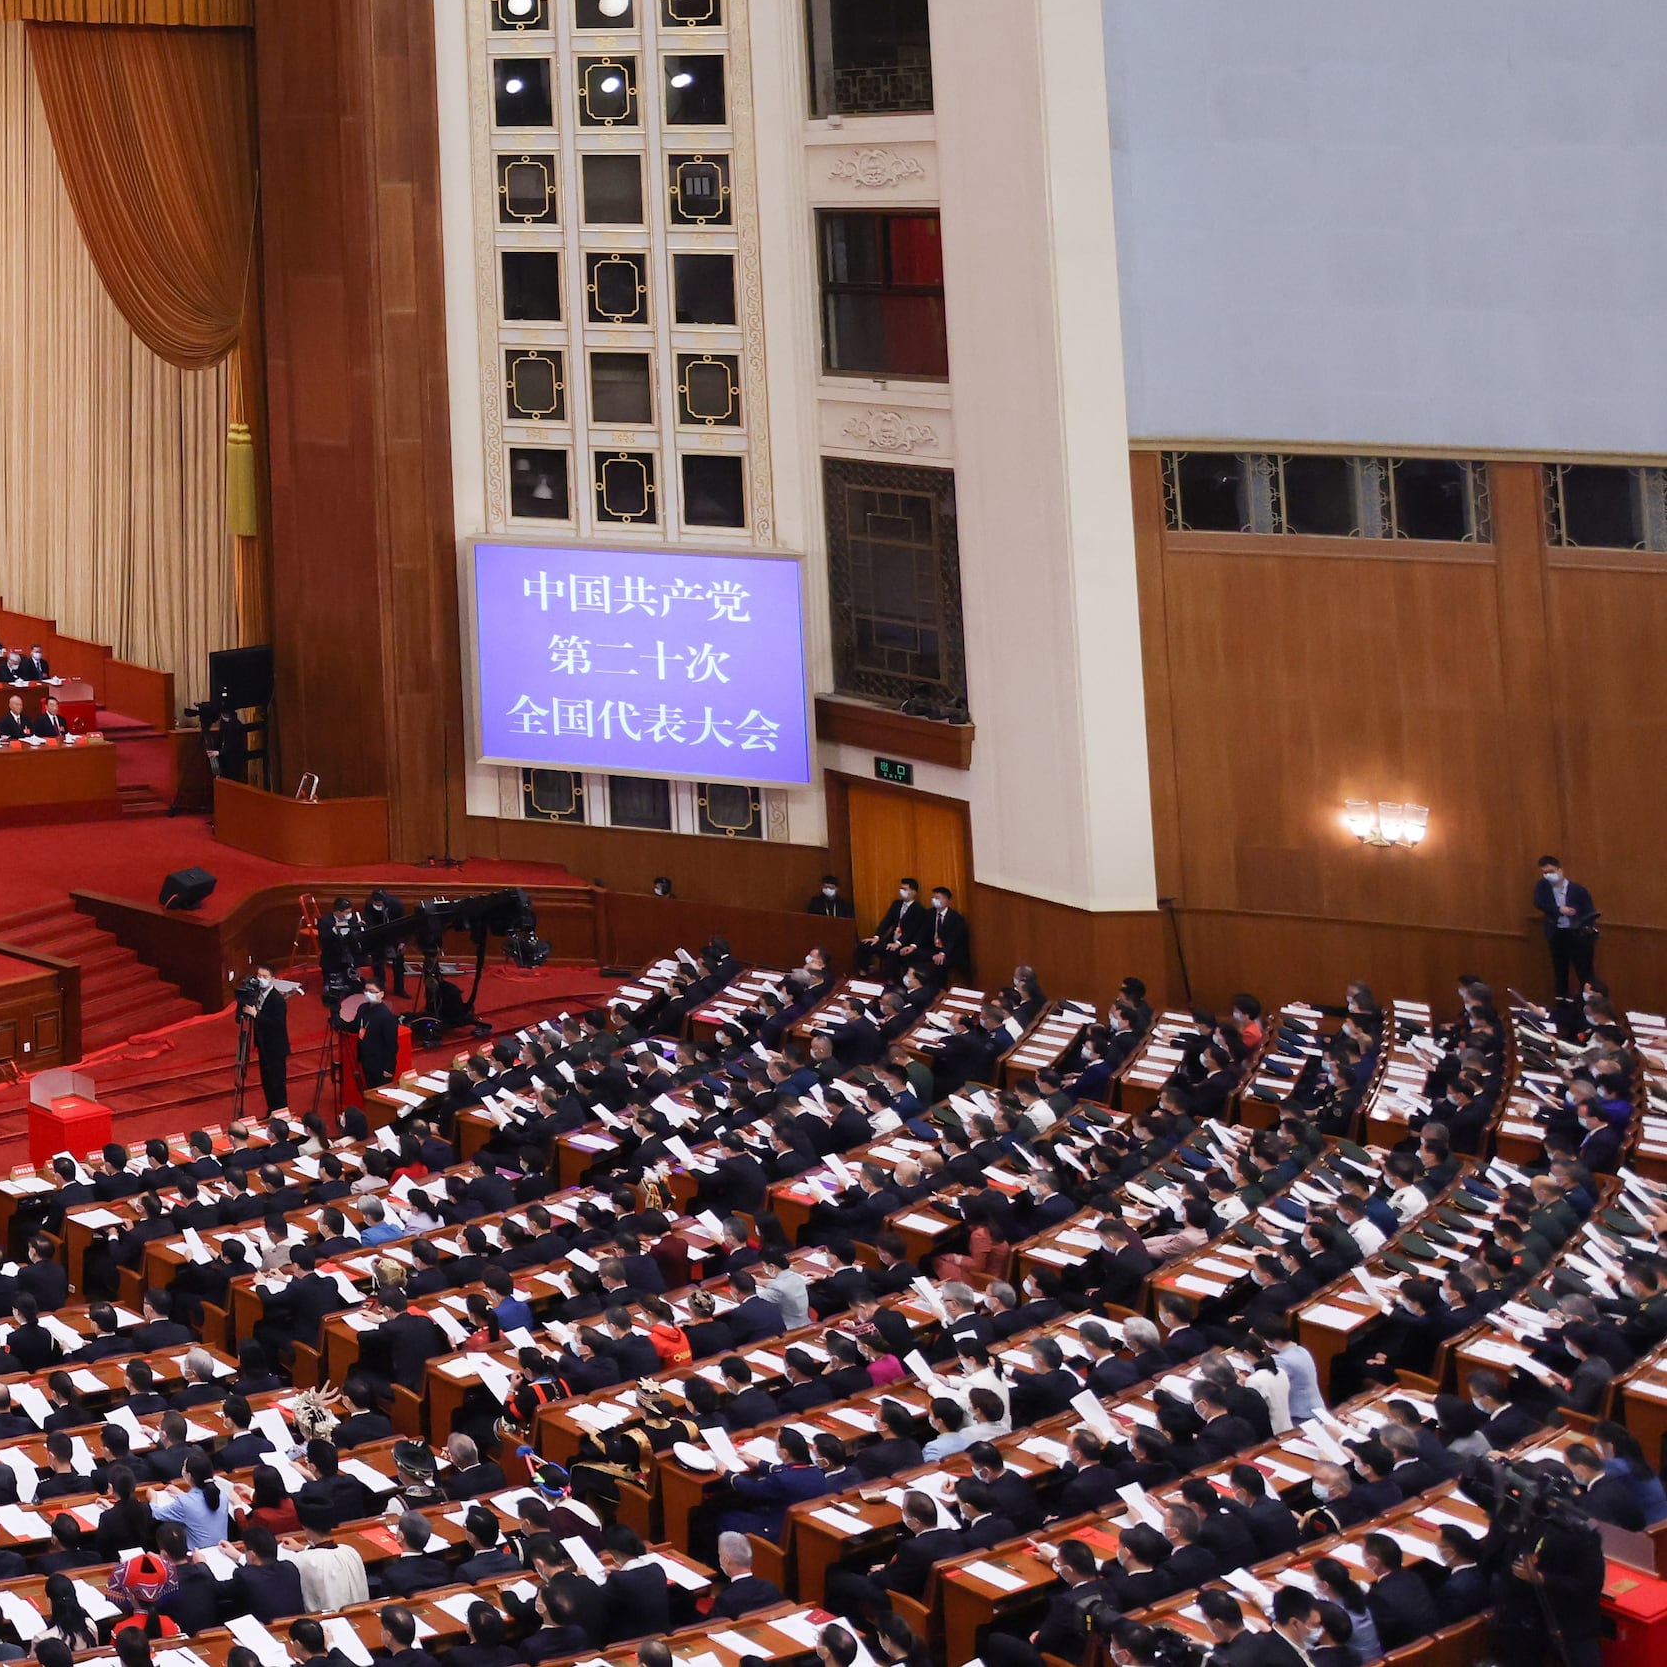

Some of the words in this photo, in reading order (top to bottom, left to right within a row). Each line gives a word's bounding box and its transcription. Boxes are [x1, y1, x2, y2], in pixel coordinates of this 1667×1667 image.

[523, 570, 752, 623] 中国共产党
[547, 634, 732, 684] 第二十次
[505, 694, 781, 752] 全国代表大会
[880, 761, 906, 776] 出口
